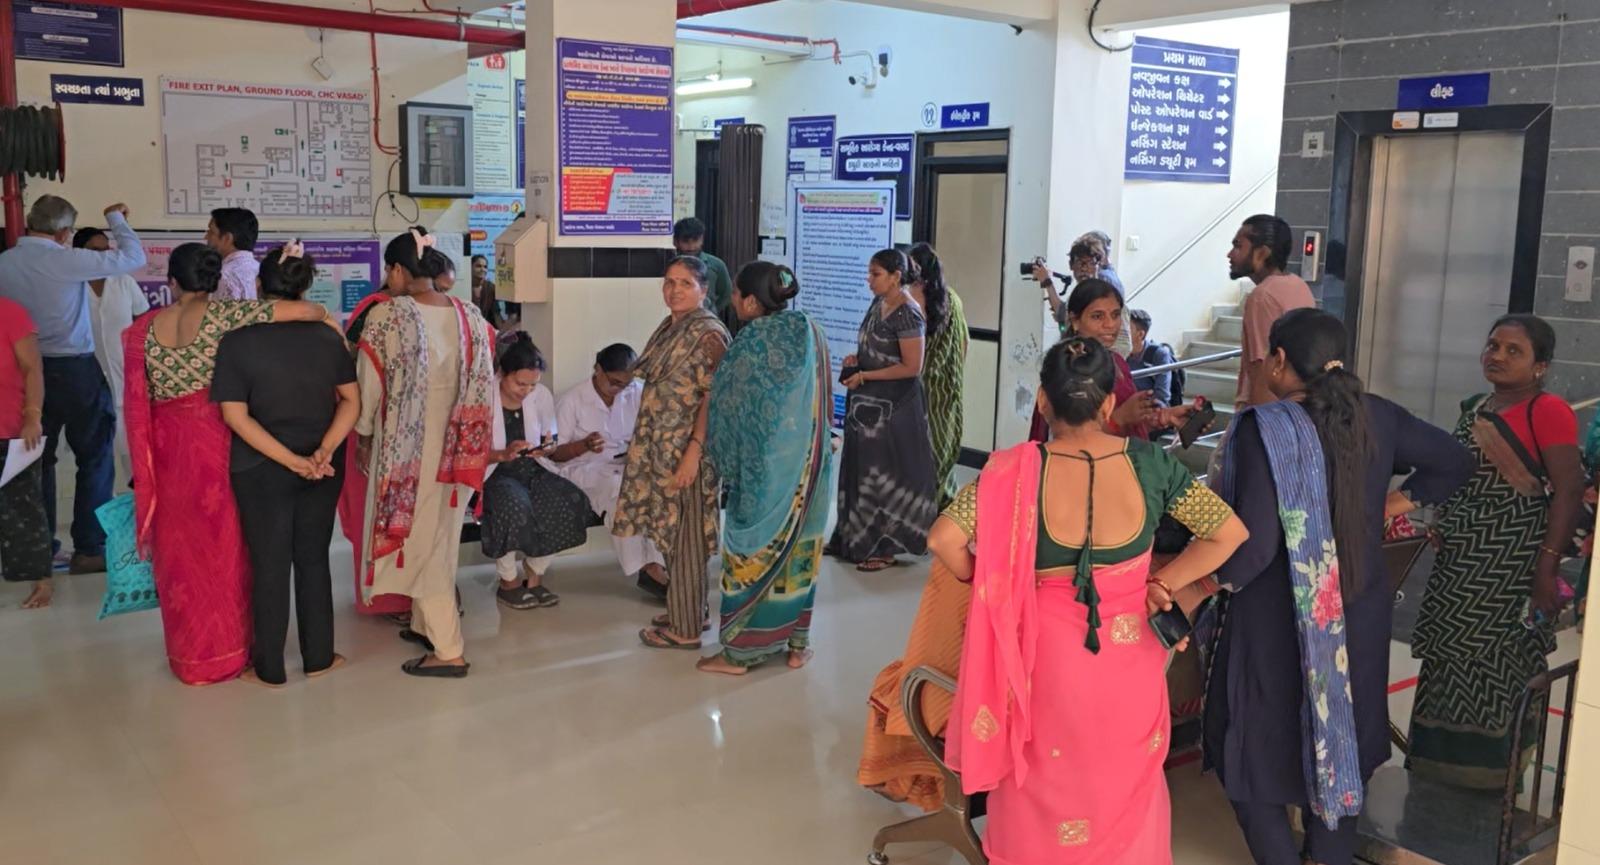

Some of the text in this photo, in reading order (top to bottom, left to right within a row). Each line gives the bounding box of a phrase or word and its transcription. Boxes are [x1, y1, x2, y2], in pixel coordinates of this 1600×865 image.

[1163, 52, 1207, 67] પ્રથમ માળ
[113, 87, 140, 101] પ્રભુતા
[168, 81, 190, 90] FIRE
[192, 82, 214, 91] EXIT
[216, 84, 242, 93] PLAN,
[244, 86, 283, 95] GROUND
[285, 88, 316, 97] FLOOR,
[317, 90, 336, 98] CHC
[1132, 84, 1205, 103] ઓપરેશન થિયેટર
[1131, 101, 1214, 120] પોસ્ટ ઓપરેશન વાર્ડ
[1177, 124, 1189, 136] રૂમ
[1161, 137, 1187, 151] સ્ટેશન
[1184, 157, 1196, 169] રૂમ
